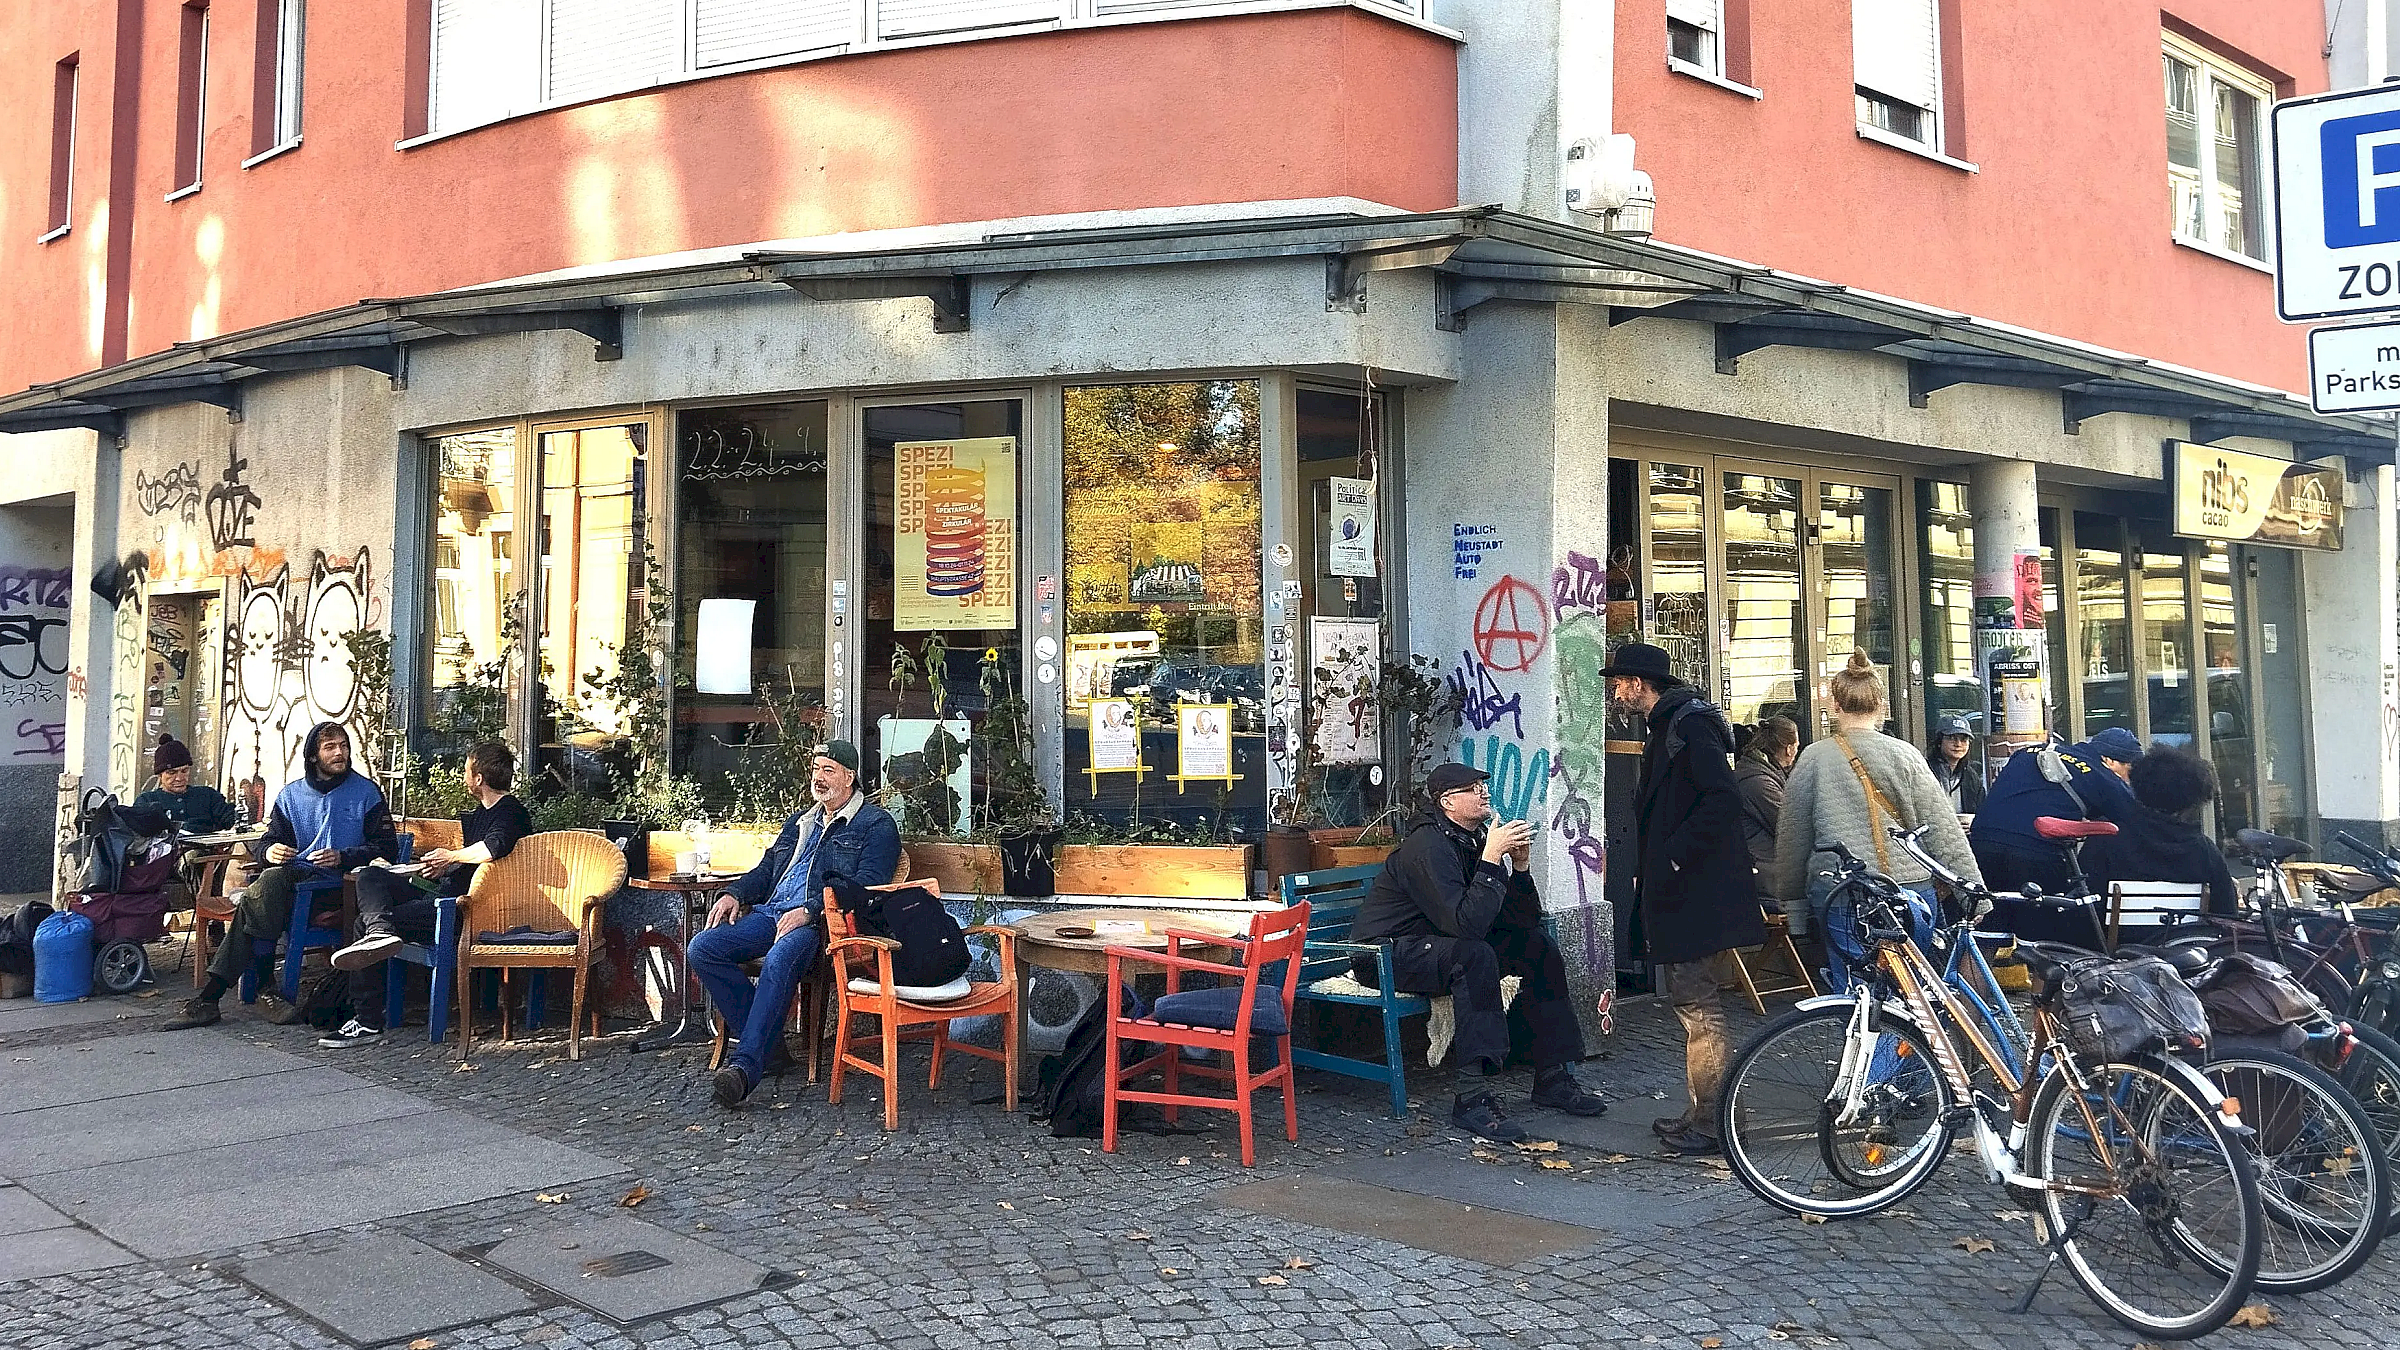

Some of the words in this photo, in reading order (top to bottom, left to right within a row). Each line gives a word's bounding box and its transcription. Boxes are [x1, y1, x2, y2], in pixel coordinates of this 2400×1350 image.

[2338, 261, 2400, 300] ZO
[900, 446, 954, 463] SPEZI
[2201, 458, 2249, 514] nibs
[2202, 512, 2229, 527] cacao
[959, 591, 1011, 608] SPEZI
